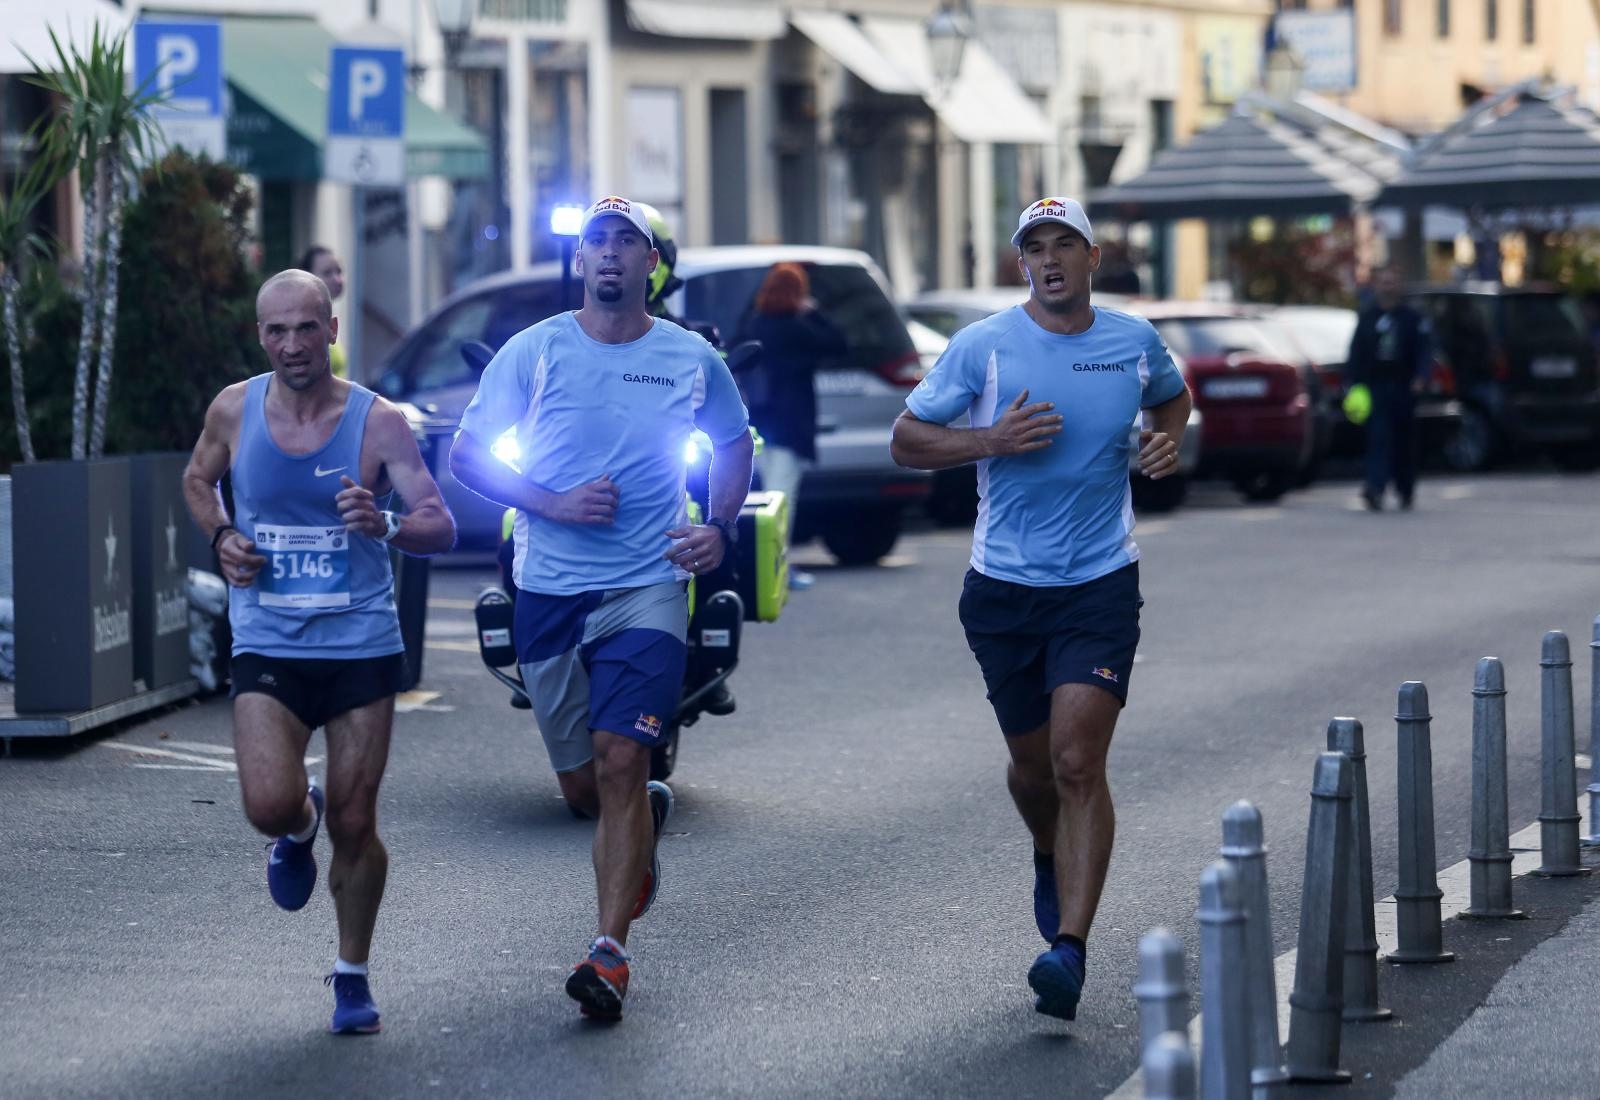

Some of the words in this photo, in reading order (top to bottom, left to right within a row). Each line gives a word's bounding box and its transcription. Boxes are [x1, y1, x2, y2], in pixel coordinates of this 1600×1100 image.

[156, 33, 199, 99] P
[348, 59, 387, 121] P
[612, 203, 630, 214] Bull
[1029, 208, 1045, 220] Red
[1046, 208, 1066, 217] Bull
[1072, 363, 1125, 372] GARMIN
[623, 373, 675, 387] GARMIN
[273, 553, 334, 579] 5146
